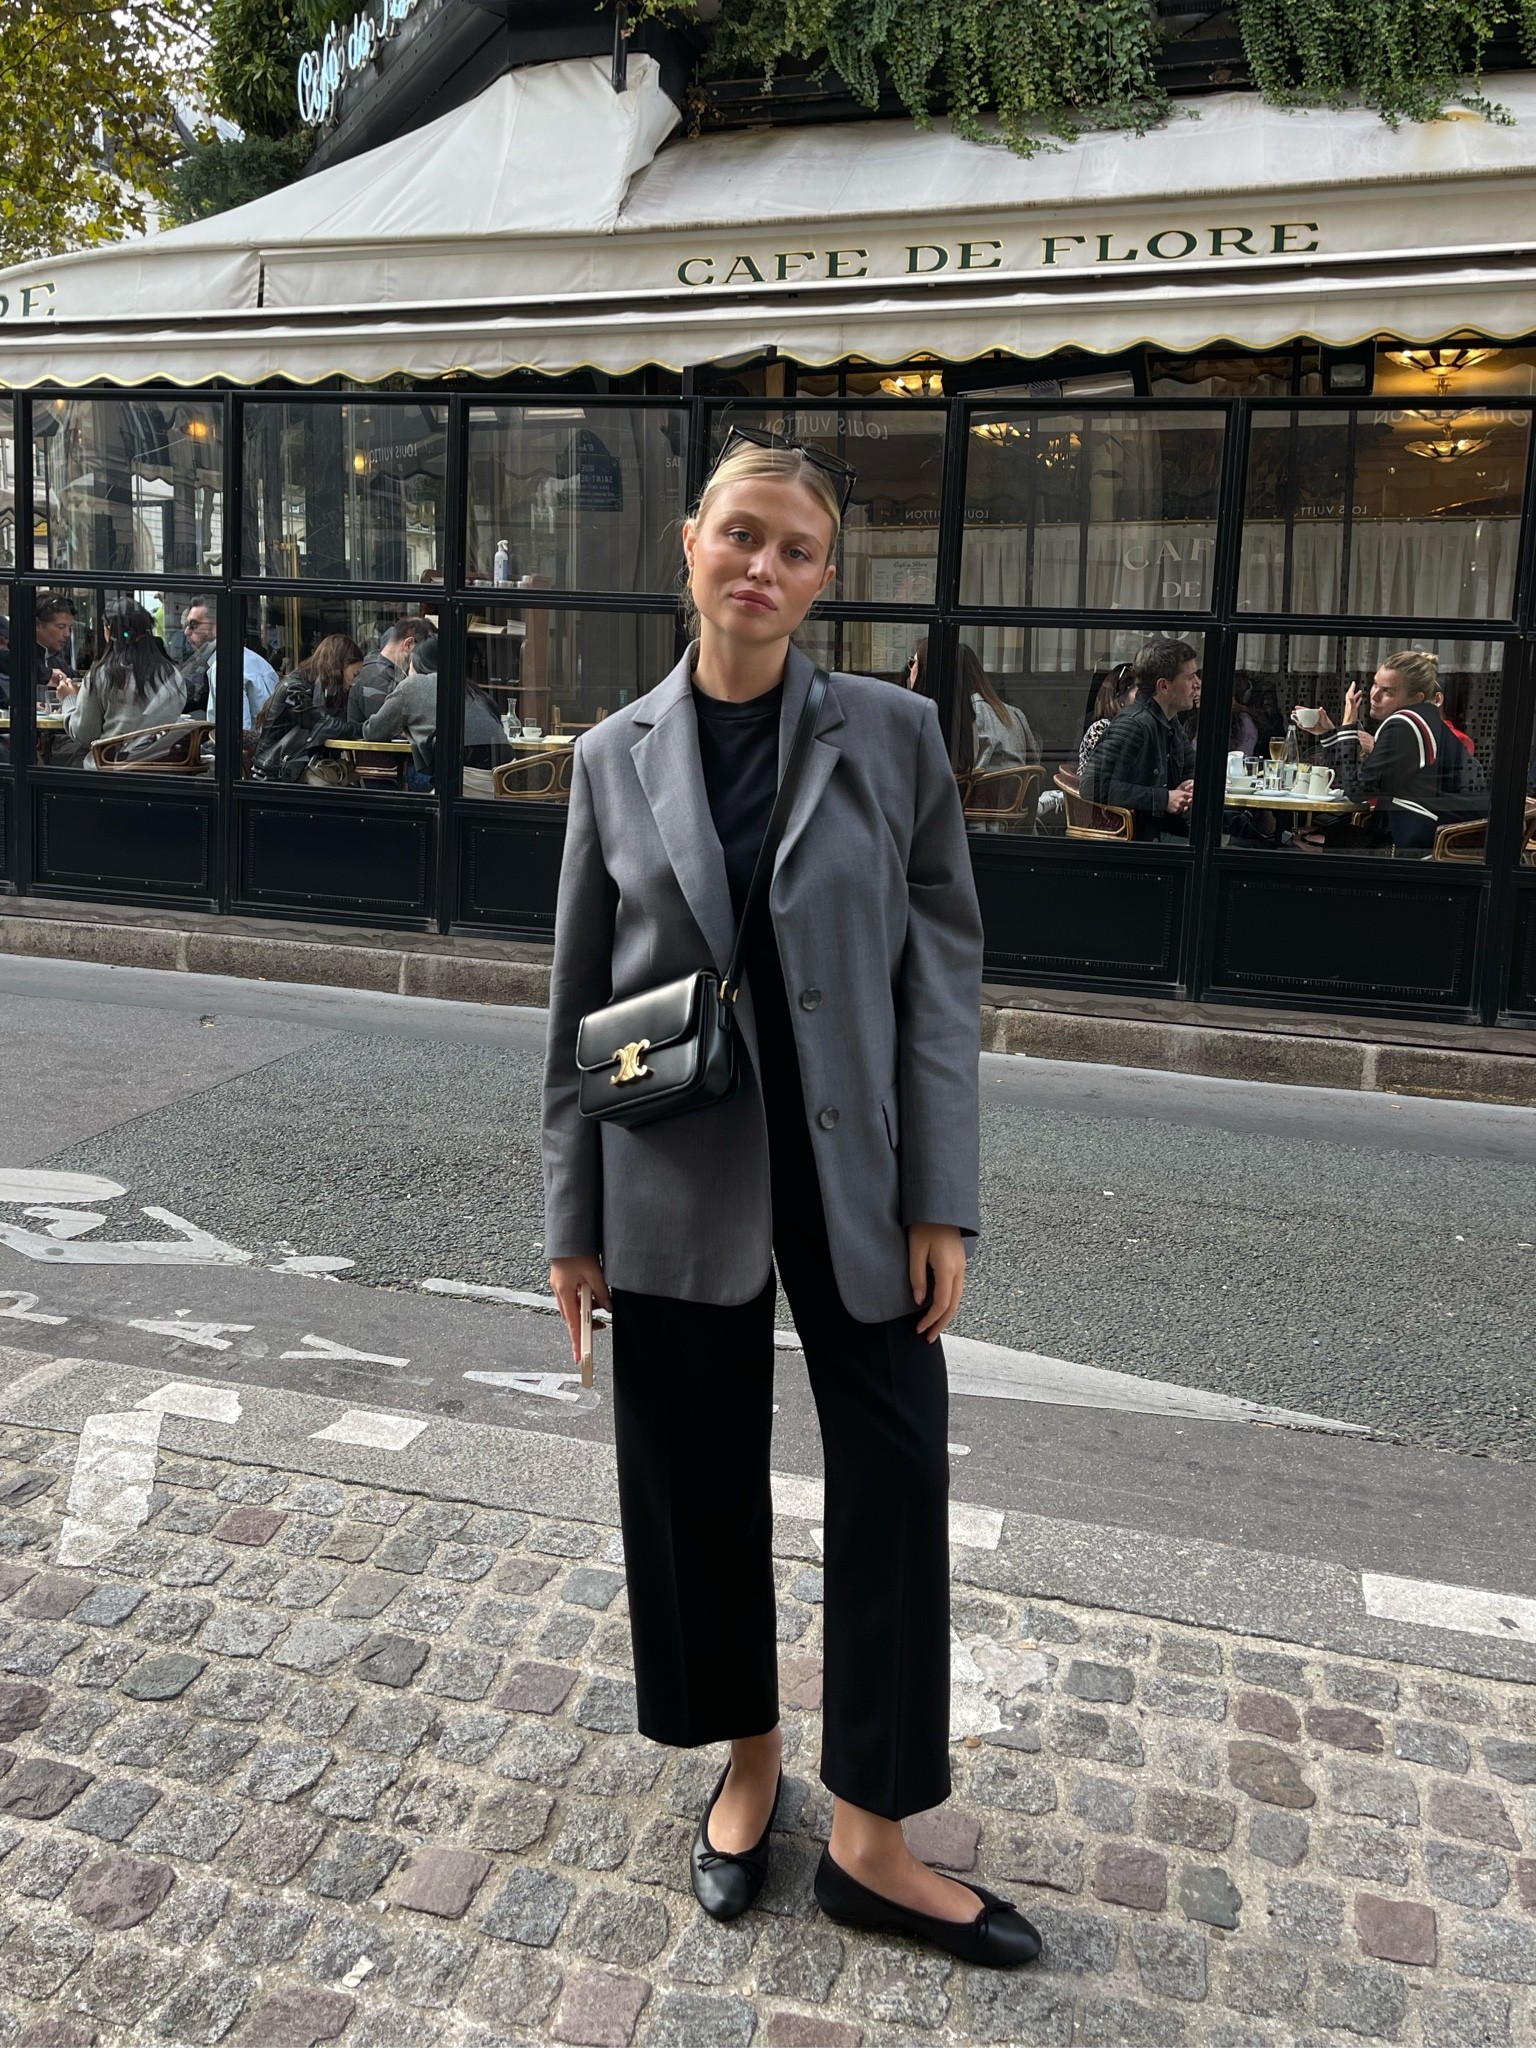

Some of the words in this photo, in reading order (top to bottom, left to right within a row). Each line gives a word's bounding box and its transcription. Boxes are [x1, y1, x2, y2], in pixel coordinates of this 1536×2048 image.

[677, 248, 869, 286] CAFE
[905, 240, 1003, 274] DE
[1042, 222, 1319, 265] FLORE
[665, 457, 680, 468] SAI
[1123, 538, 1215, 571] CAF
[1162, 581, 1201, 598] DE
